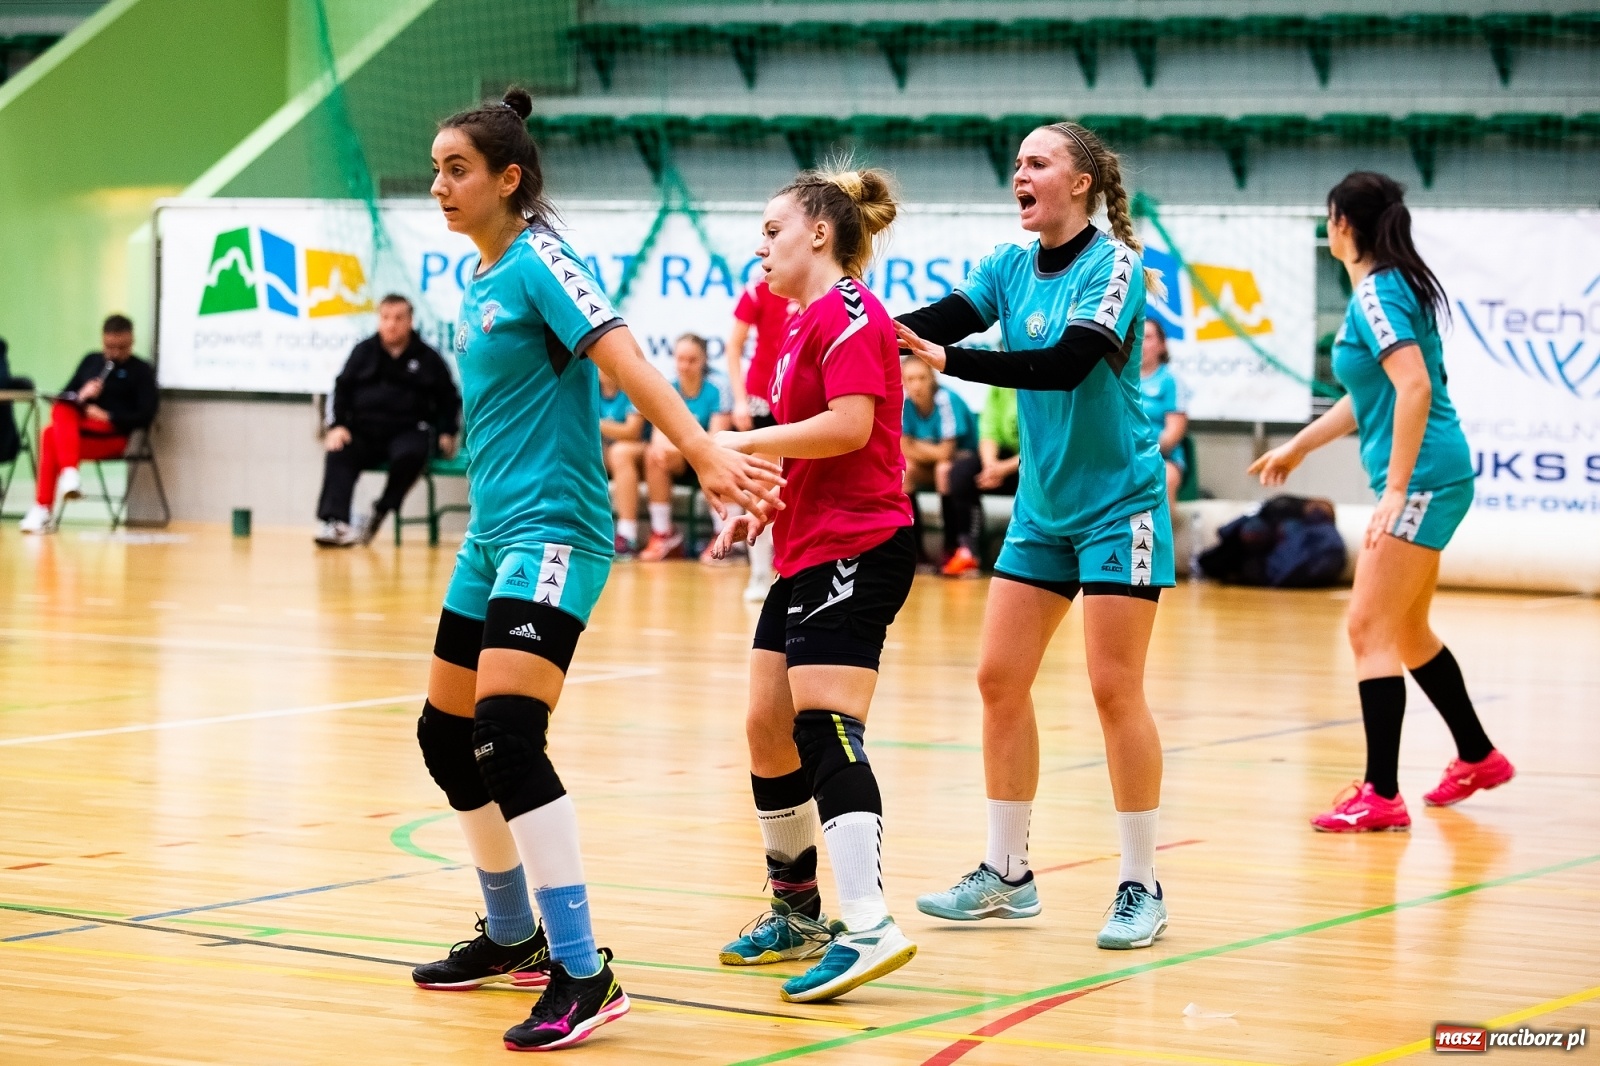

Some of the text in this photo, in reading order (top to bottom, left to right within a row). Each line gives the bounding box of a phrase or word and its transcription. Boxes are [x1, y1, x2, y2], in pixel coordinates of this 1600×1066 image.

[505, 578, 530, 588] SELECT
[509, 629, 542, 642] adidas
[758, 810, 796, 820] ummel
